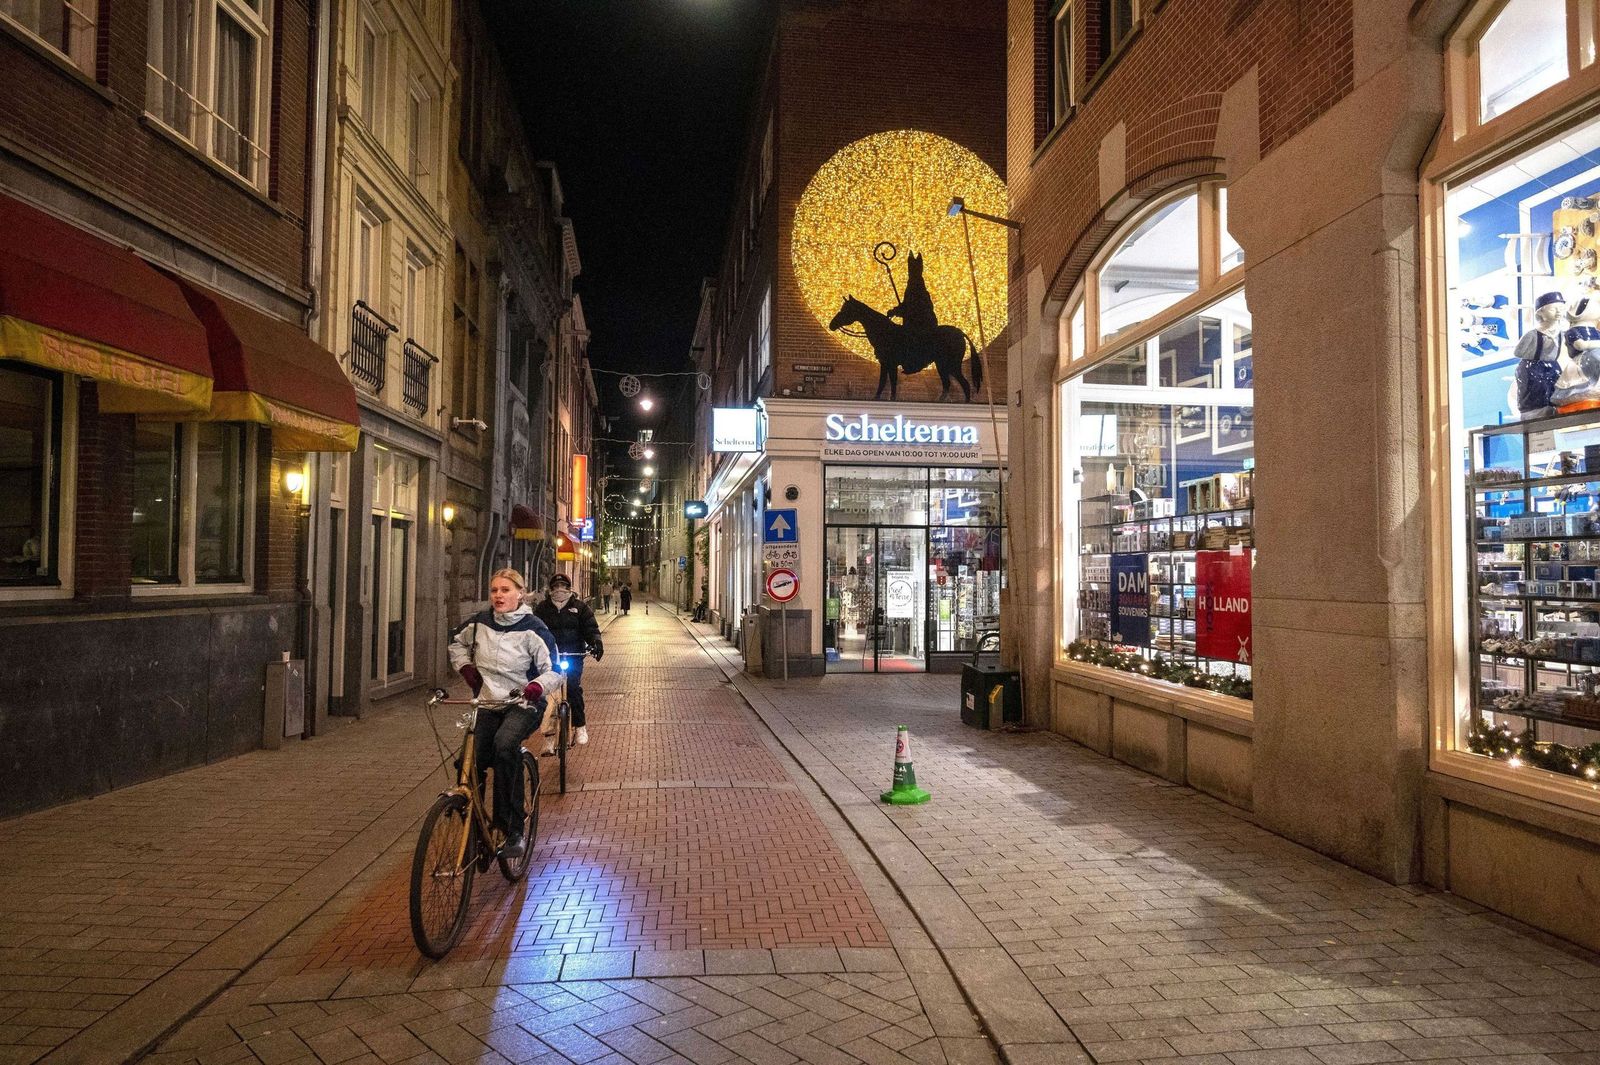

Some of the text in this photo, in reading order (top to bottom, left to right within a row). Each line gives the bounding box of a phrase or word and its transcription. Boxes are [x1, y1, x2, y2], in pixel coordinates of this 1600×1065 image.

[111, 354, 187, 397] HOTEL
[826, 413, 979, 444] Scheltema
[824, 448, 844, 456] ELKE
[862, 449, 885, 457] OPEN
[901, 450, 923, 458] 10:00
[583, 519, 593, 534] P
[1118, 572, 1147, 593] DAM
[1118, 606, 1148, 618] SOUVENIRS
